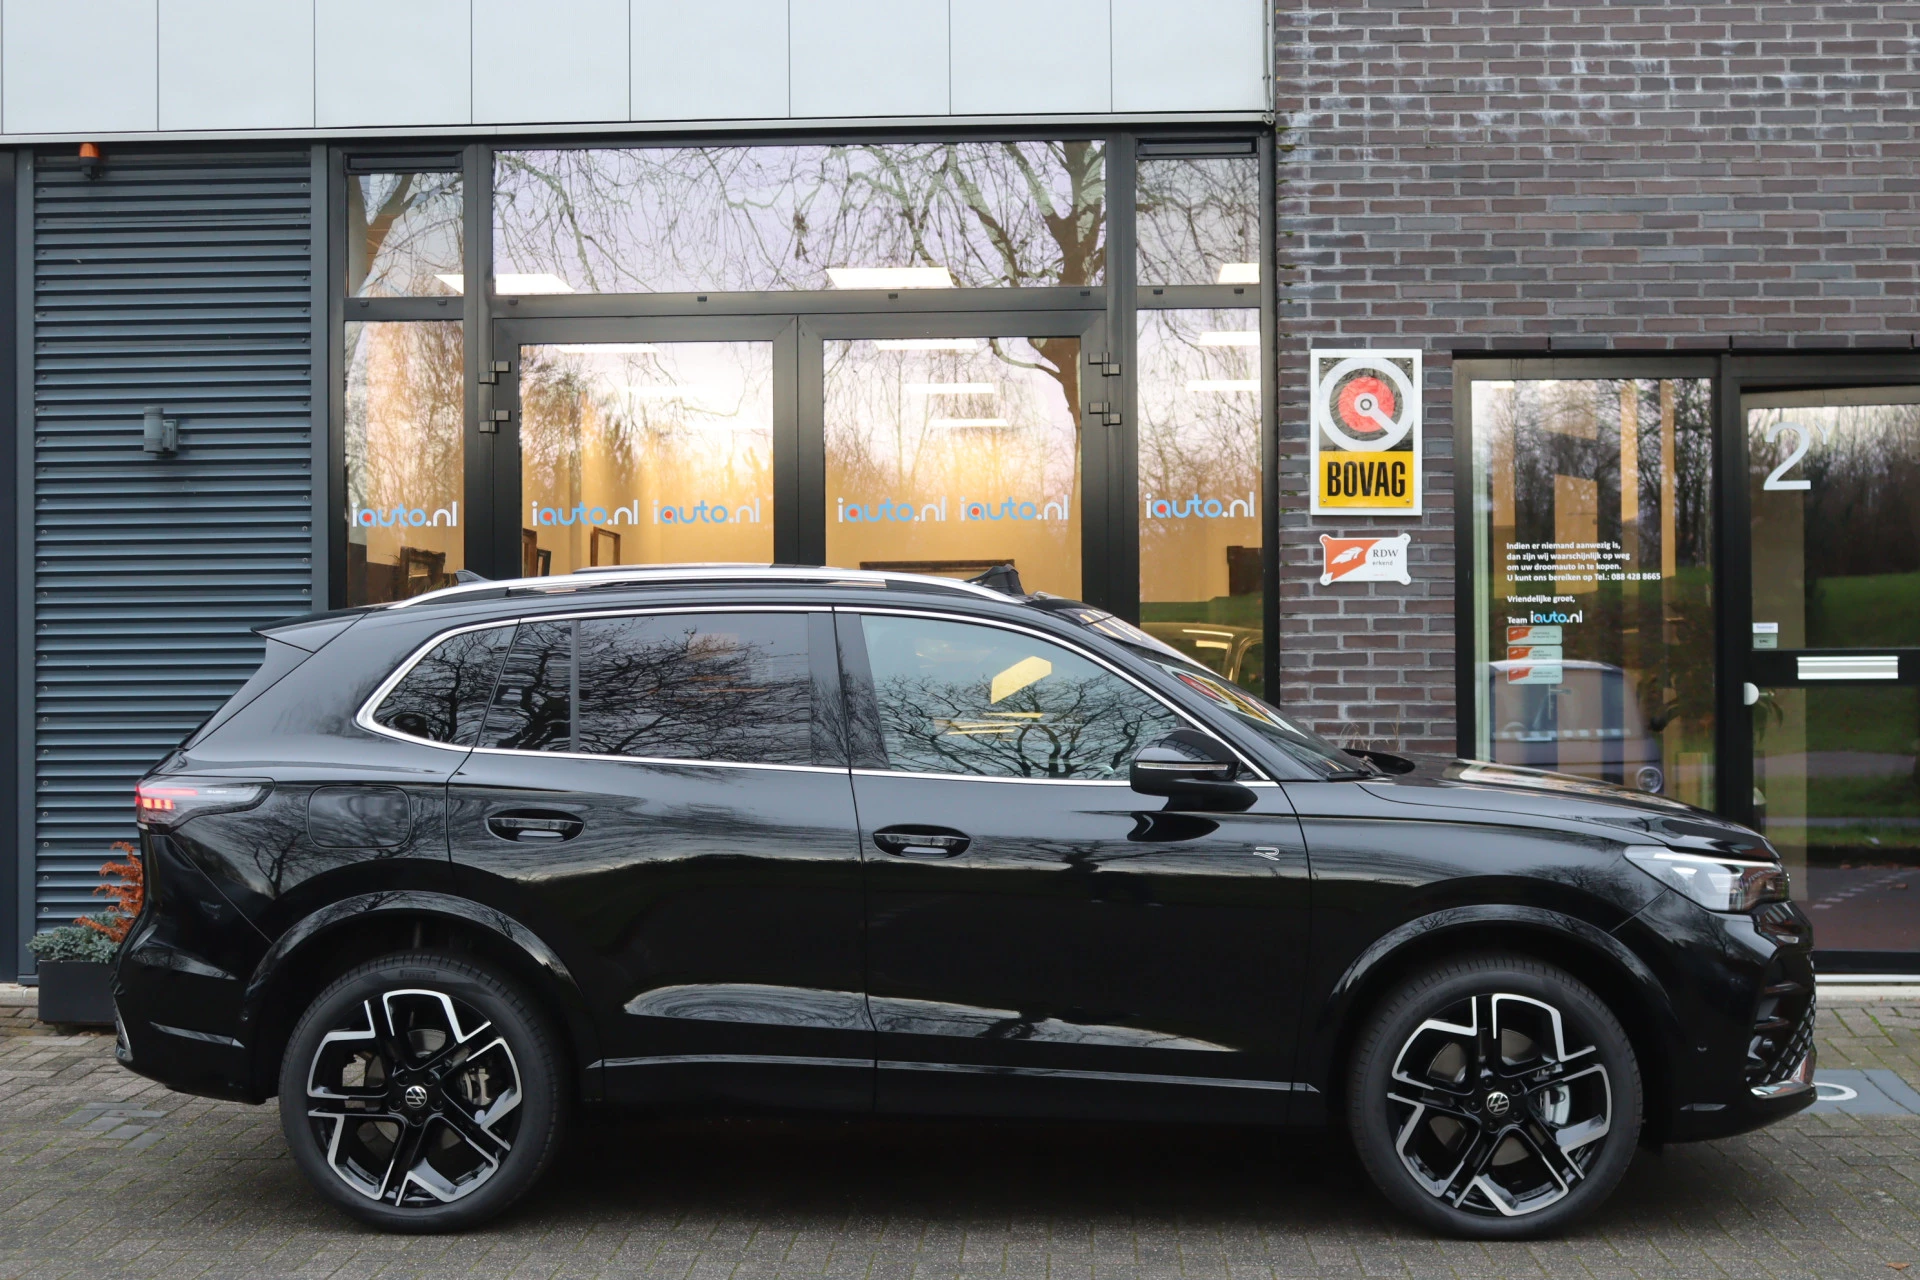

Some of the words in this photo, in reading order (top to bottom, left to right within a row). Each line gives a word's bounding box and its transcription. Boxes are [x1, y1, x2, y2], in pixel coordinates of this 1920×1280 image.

[1327, 461, 1406, 497] BOVAG
[352, 501, 457, 527] iauto.nl
[532, 500, 639, 526] iauto.nl
[653, 498, 760, 524] iauto.nl
[838, 496, 946, 522] iauto.nl
[959, 494, 1069, 521] iauto.nl
[1145, 491, 1255, 519] iauto.nl
[1372, 549, 1399, 558] RDW
[1506, 542, 1530, 550] Indien
[1541, 542, 1575, 550] niemand
[1576, 541, 1611, 551] aanwezig
[1612, 541, 1621, 549] is,
[1522, 553, 1535, 561] zijn
[1537, 552, 1549, 561] wij
[1550, 552, 1601, 561] waarschijnlijk
[1534, 563, 1576, 571] droomauto
[1596, 562, 1621, 571] kopen.
[1583, 574, 1593, 582] op
[1611, 572, 1625, 580] 088
[1626, 572, 1641, 580] 428
[1642, 572, 1661, 580] 8665
[1506, 595, 1552, 603] Vriendelijke
[1552, 595, 1576, 604] groet,
[1507, 616, 1528, 624] Team
[1530, 609, 1583, 624] iauto.nl
